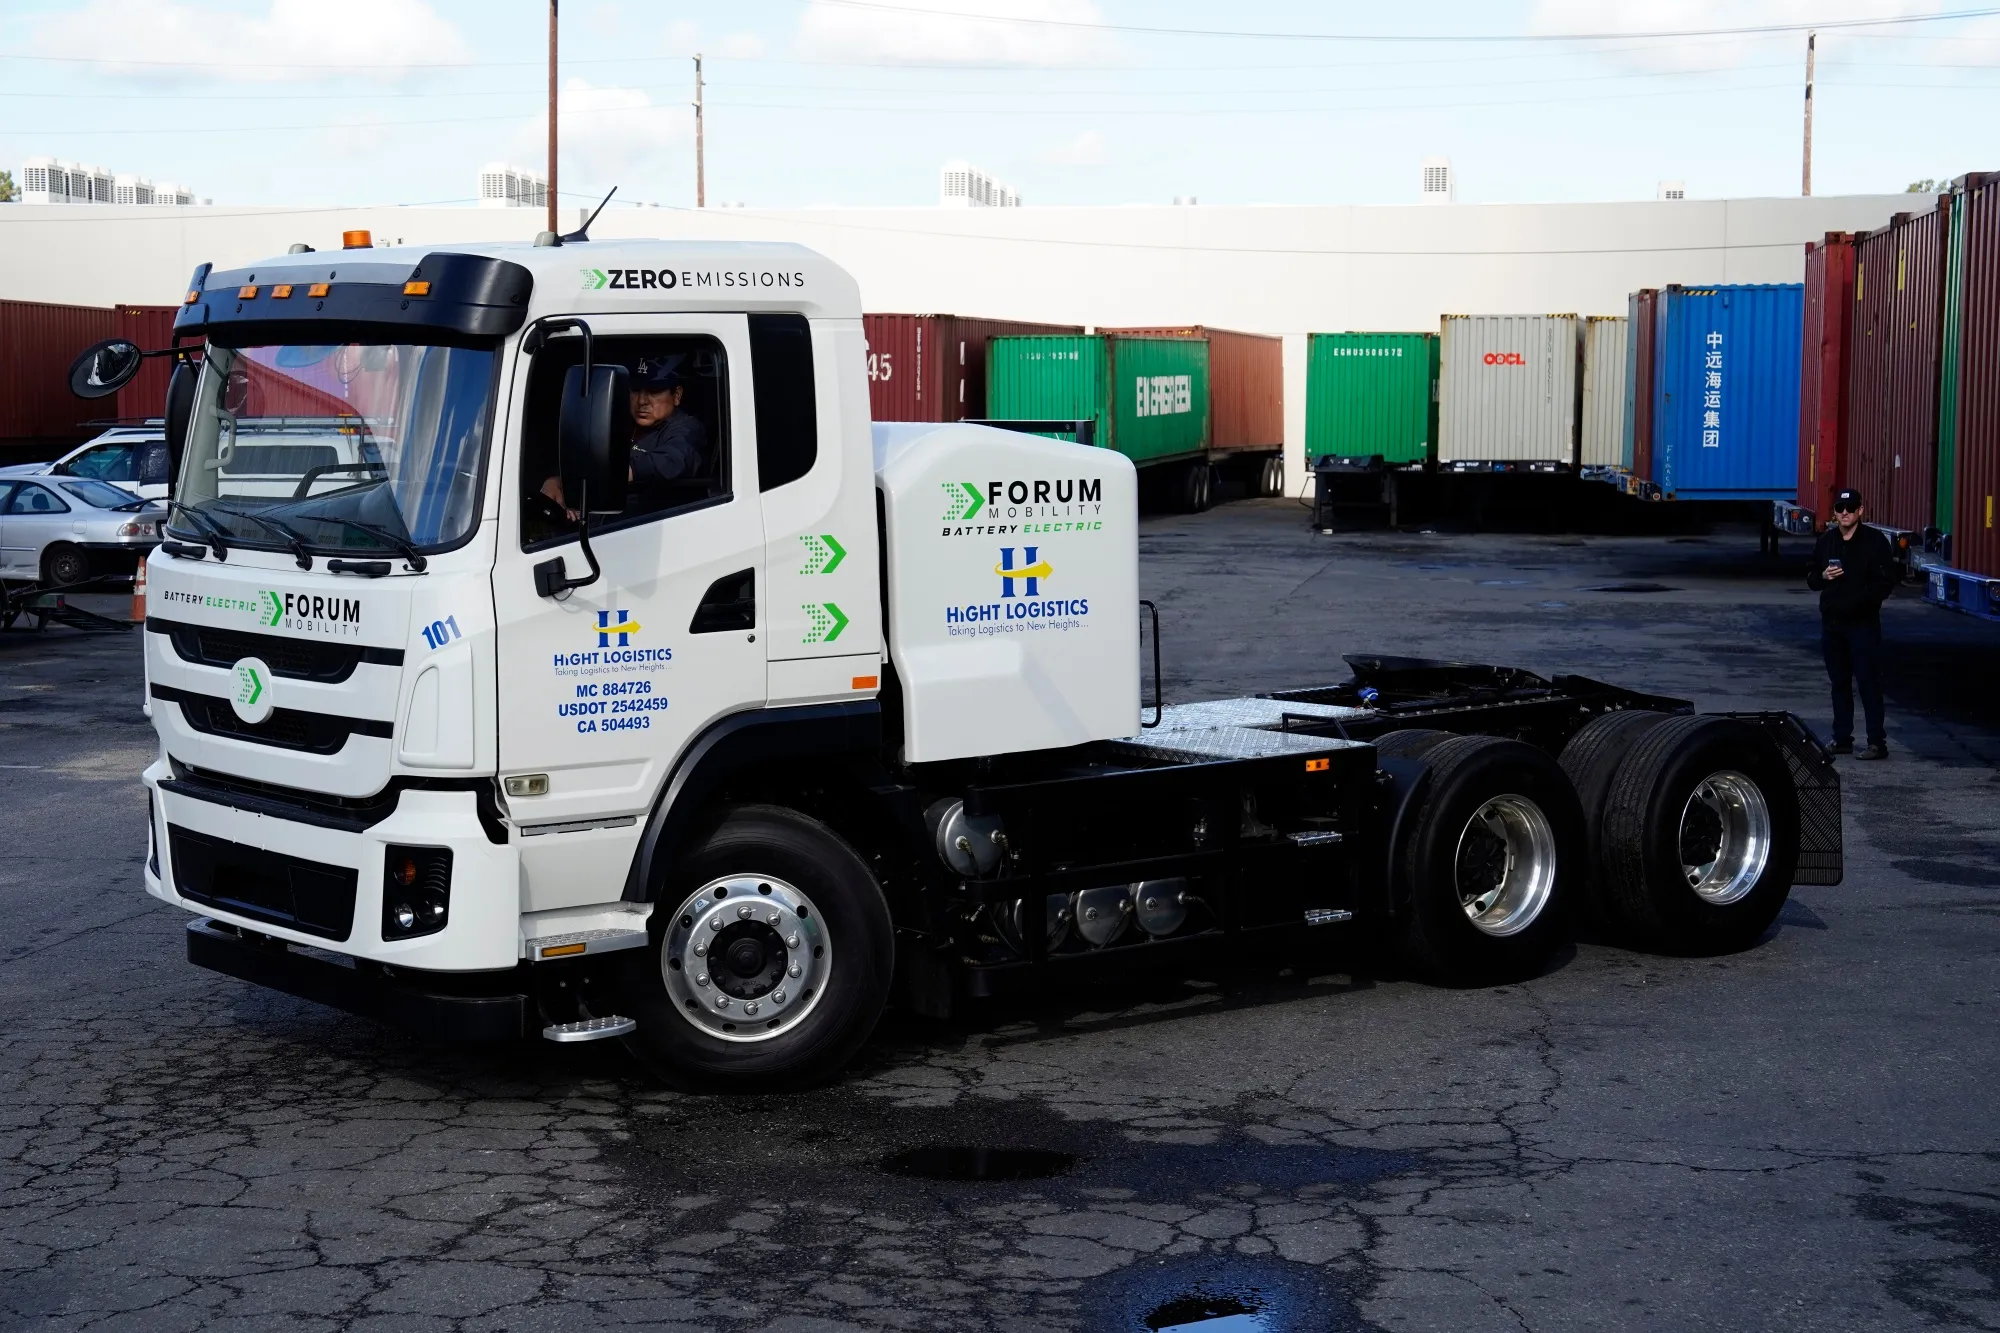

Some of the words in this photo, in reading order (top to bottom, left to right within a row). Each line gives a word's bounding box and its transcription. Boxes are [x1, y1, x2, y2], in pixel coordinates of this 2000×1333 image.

[607, 269, 677, 289] ZERO
[681, 271, 805, 287] EMISSIONS
[637, 357, 649, 375] LA
[866, 353, 893, 382] 45
[1483, 352, 1526, 366] OOCL
[1702, 330, 1723, 449] 中远海运集团
[988, 479, 1101, 505] FORUM
[989, 505, 1101, 519] MOBILITY
[941, 524, 1019, 537] BATTERY
[1023, 521, 1103, 534] ELECTRIC
[164, 590, 204, 605] BATTERY
[206, 596, 257, 612] ELECTRIC
[285, 592, 361, 624] FORUM
[1007, 599, 1088, 619] LOGISTICS
[285, 617, 360, 637] MOBILITY
[421, 614, 463, 651] 101
[947, 624, 976, 638] Taking
[978, 620, 1014, 637] Logistics
[1015, 620, 1025, 632] to
[1027, 618, 1046, 631] New
[604, 648, 673, 664] LOGISTICS
[555, 665, 579, 677] Taking
[580, 663, 610, 676] Logistics
[611, 665, 620, 673] to
[622, 664, 637, 672] New
[576, 684, 598, 698] MC
[602, 680, 652, 697] 884726
[558, 701, 607, 717] USDOT
[611, 697, 669, 714] 2542459
[577, 720, 597, 733] CA
[601, 716, 651, 731] 504493
